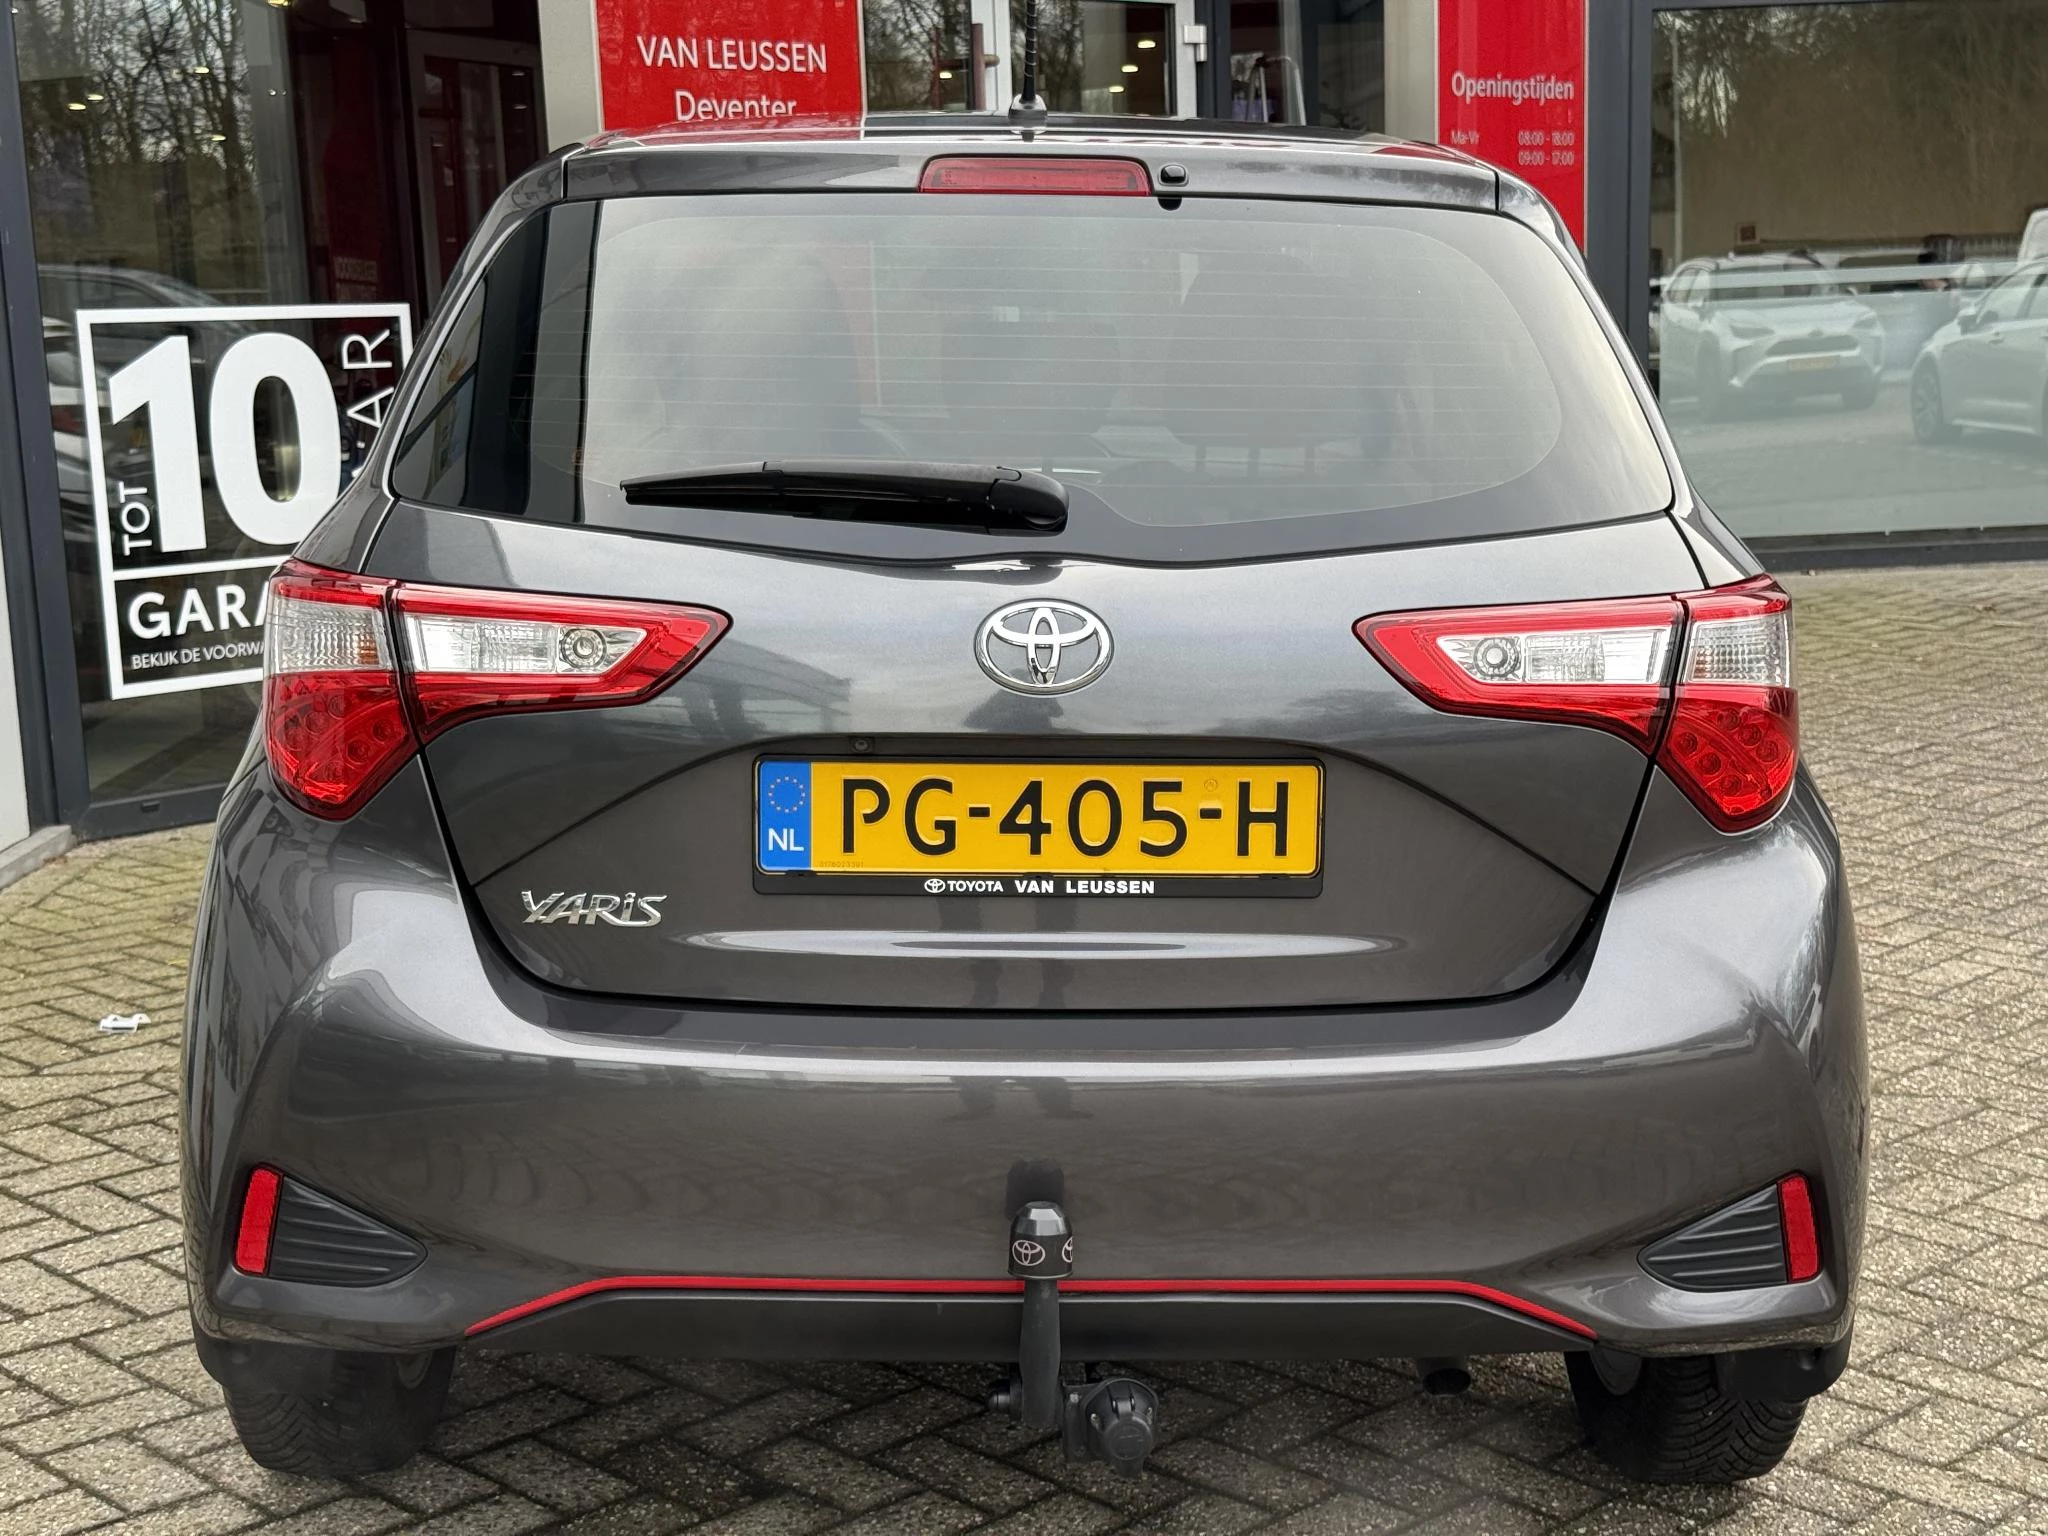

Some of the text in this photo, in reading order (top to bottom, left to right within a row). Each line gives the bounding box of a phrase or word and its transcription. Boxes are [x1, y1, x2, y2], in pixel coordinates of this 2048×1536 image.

[636, 35, 828, 74] VAN LEUSSEN
[1451, 71, 1575, 106] Openingstijden
[674, 89, 797, 121] Deventer
[1451, 130, 1480, 145] Ma-Vr
[1518, 131, 1545, 146] 08:00
[1552, 131, 1575, 146] 18:00
[1518, 151, 1545, 166] 09:00
[1551, 151, 1575, 166] 17:00
[108, 332, 342, 553] 10
[118, 481, 153, 556] TOT
[131, 649, 180, 670] BEKIJK
[180, 647, 202, 664] DE
[841, 773, 1290, 857] PG-405-H
[767, 828, 804, 852] NL
[947, 879, 1156, 895] TOYOTA VAN LEUSSEN
